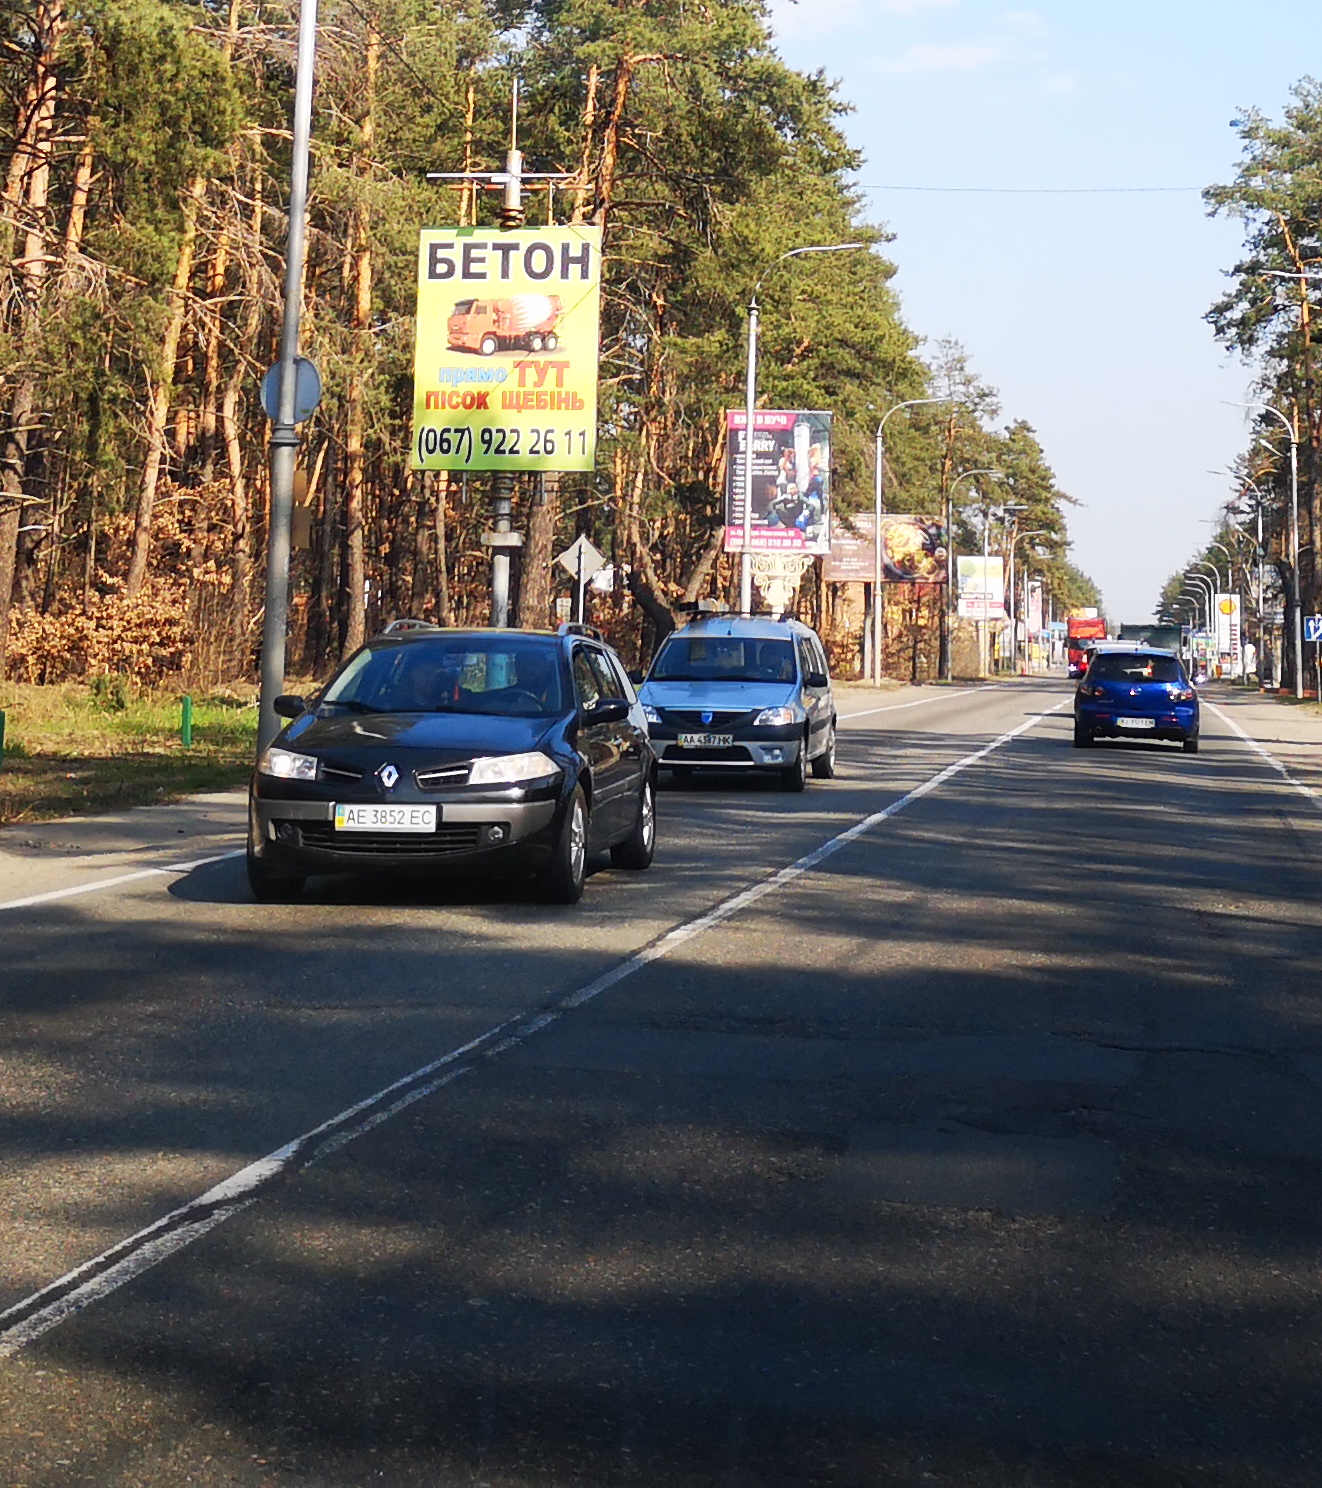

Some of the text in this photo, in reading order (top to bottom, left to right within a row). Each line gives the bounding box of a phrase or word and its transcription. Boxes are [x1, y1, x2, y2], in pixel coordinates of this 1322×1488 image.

[427, 242, 590, 280] БЕТОН
[439, 360, 570, 388] прямо ТУТ
[425, 390, 585, 413] ПІСОК ЩЕБІНЬ
[418, 425, 586, 463] (067) 922 26 11
[346, 809, 432, 825] AE 3852 EC
